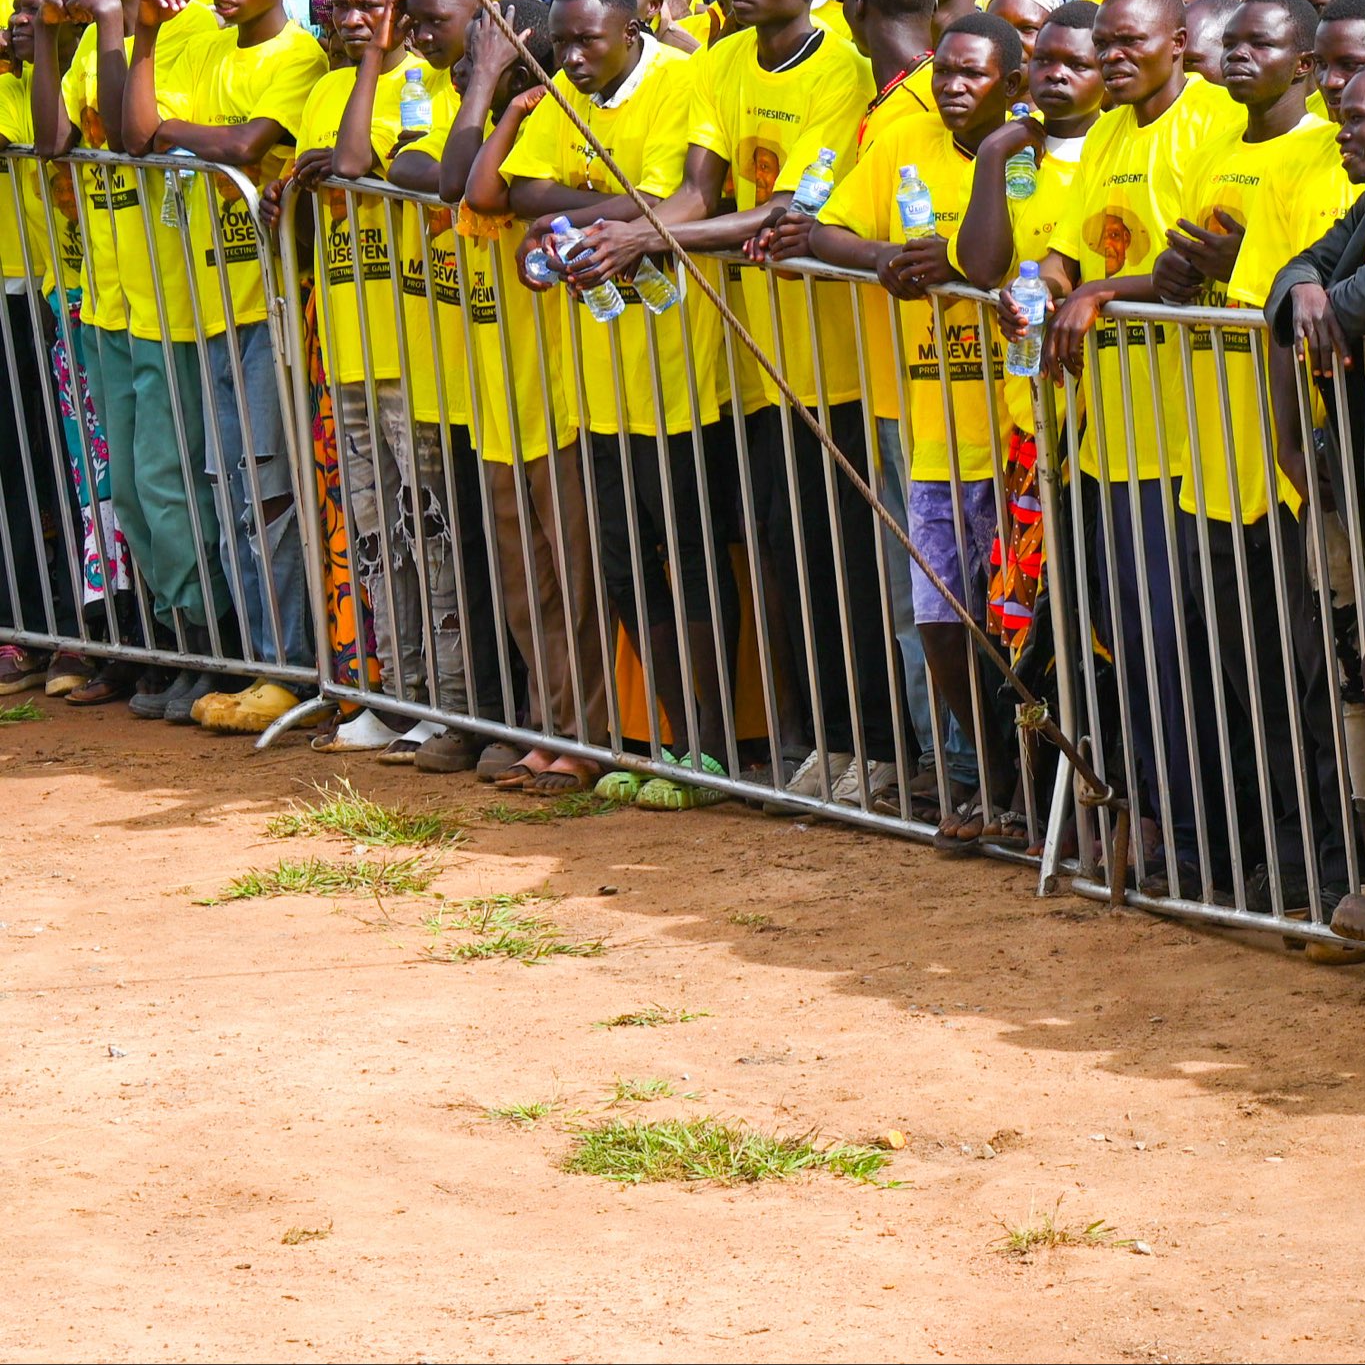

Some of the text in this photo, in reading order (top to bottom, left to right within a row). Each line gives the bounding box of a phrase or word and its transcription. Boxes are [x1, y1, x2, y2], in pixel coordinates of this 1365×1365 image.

[329, 244, 388, 264] USEVEN
[408, 258, 459, 286] MSEVE
[919, 364, 961, 375] PROTING
